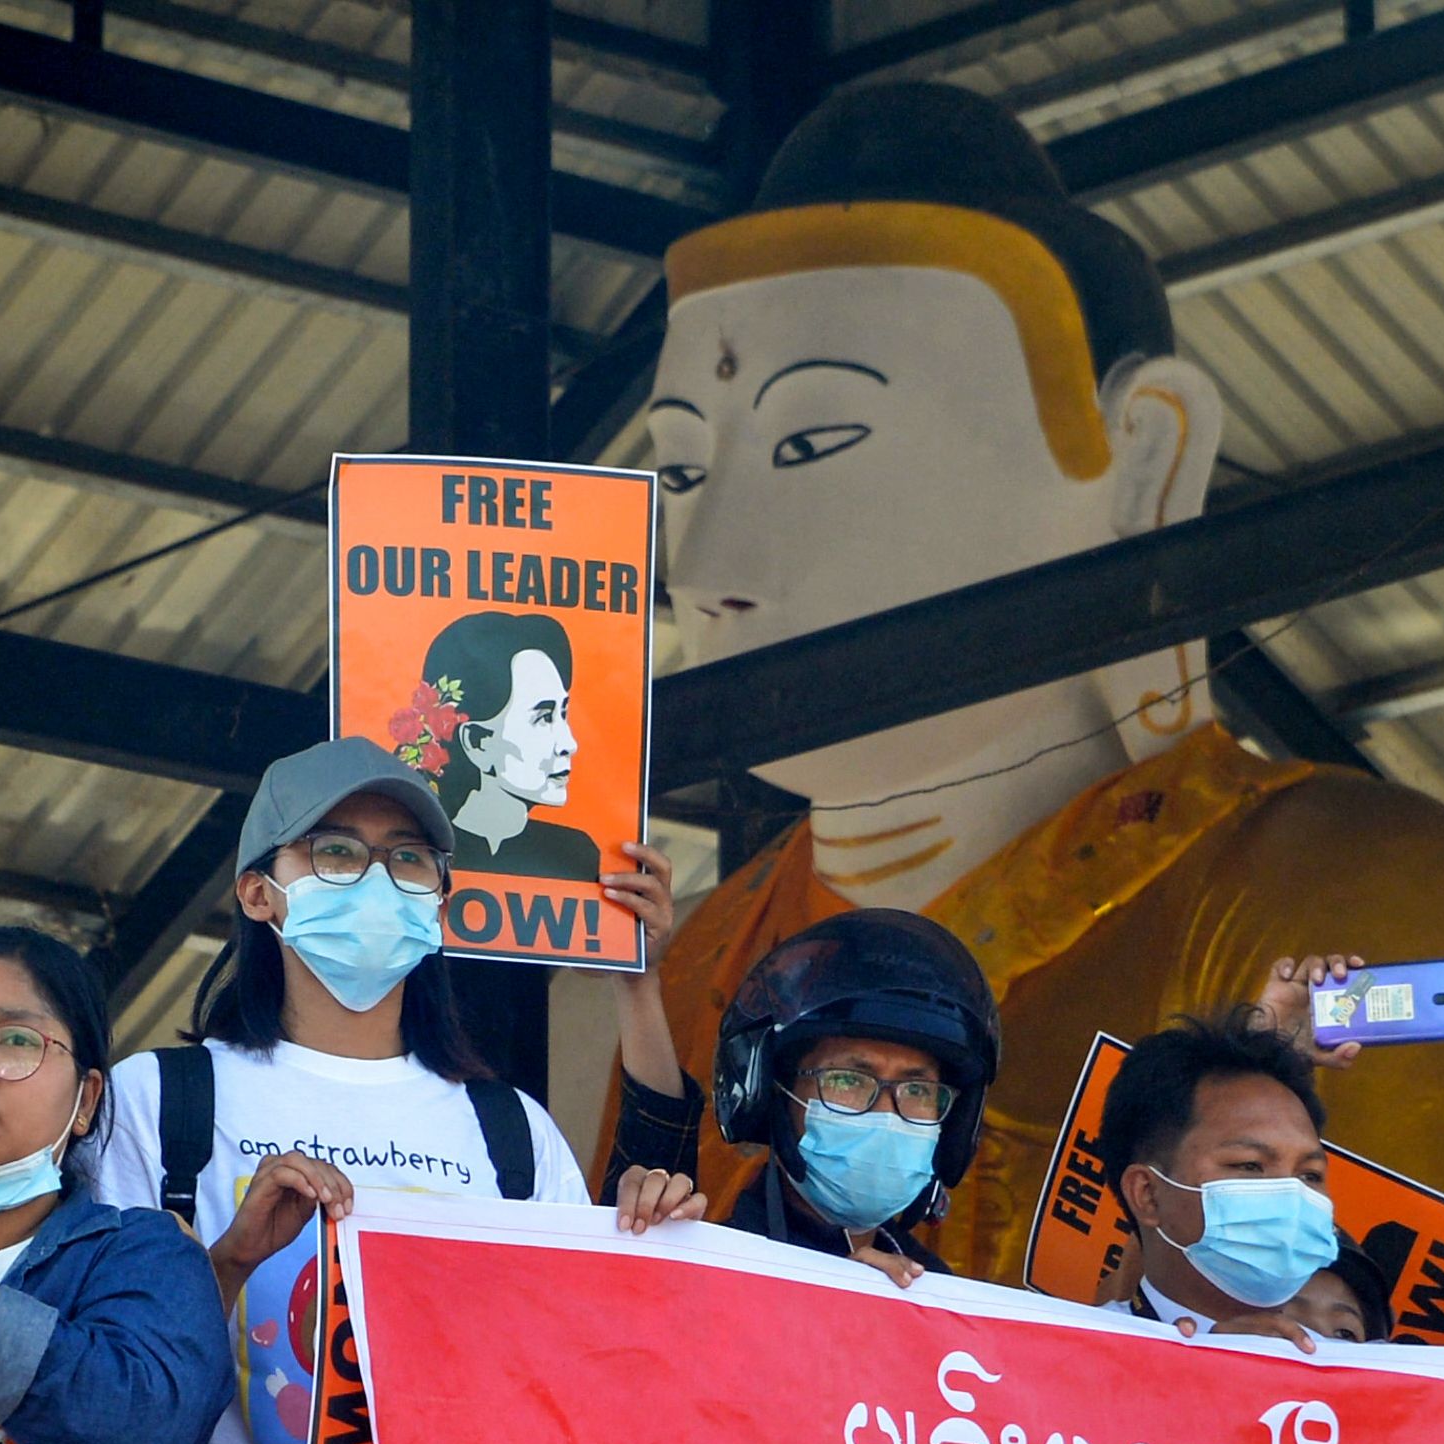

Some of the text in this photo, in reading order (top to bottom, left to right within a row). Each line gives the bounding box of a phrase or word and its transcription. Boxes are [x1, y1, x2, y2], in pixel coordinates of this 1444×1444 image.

[441, 474, 554, 531] FREE
[346, 544, 639, 614] OUR LEADER
[448, 887, 601, 953] OW!
[239, 1134, 471, 1184] am strawberry
